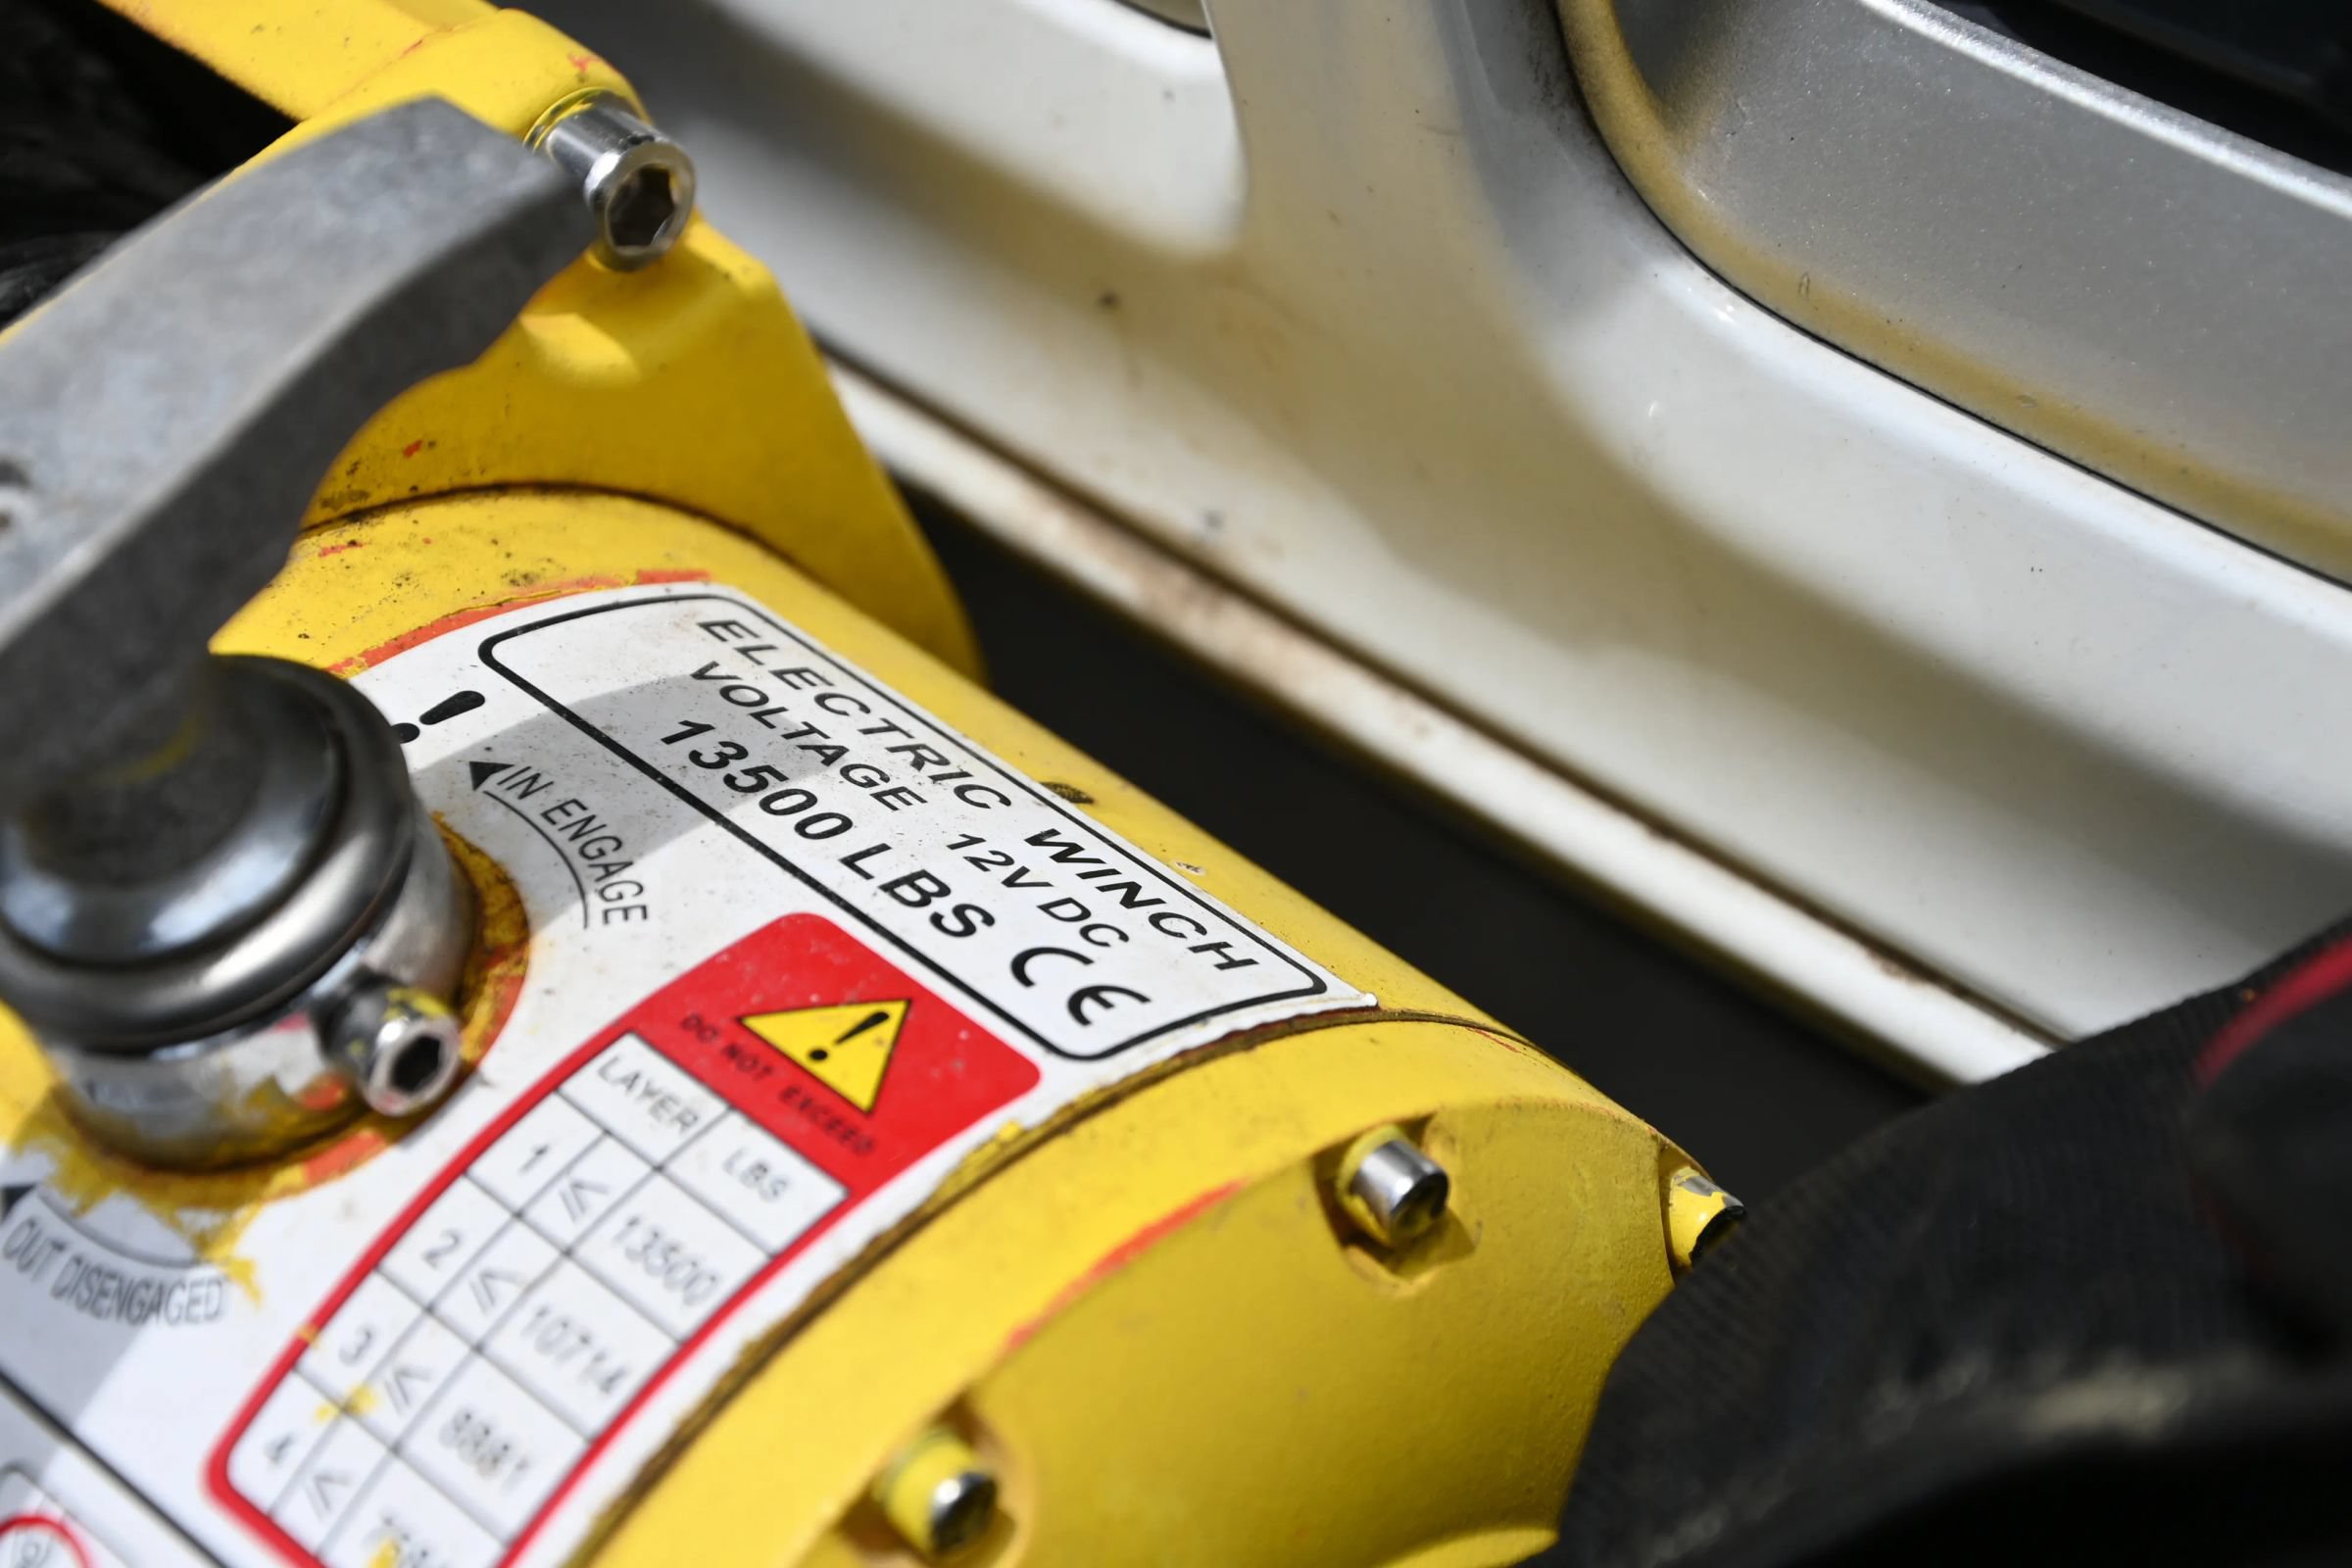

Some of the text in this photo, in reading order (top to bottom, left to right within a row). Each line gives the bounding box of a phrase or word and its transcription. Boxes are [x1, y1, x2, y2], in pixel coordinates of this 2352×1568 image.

[495, 764, 649, 926] IN ENGAGE
[661, 718, 997, 939] 13500 LBS
[689, 661, 1131, 949] VOLTAGE 12V DC
[698, 619, 1260, 971] ELECTRIC WINCH
[598, 1055, 789, 1200] LAYER LBS
[678, 1012, 876, 1156] DO NOT EXCEED
[3, 1216, 230, 1327] OUT DISENGAGED
[518, 1145, 551, 1176] 1
[612, 1214, 720, 1307] 13500
[338, 1325, 376, 1365] 3
[422, 1228, 465, 1269] 2
[520, 1304, 632, 1396] 10714
[264, 1432, 296, 1466] 4
